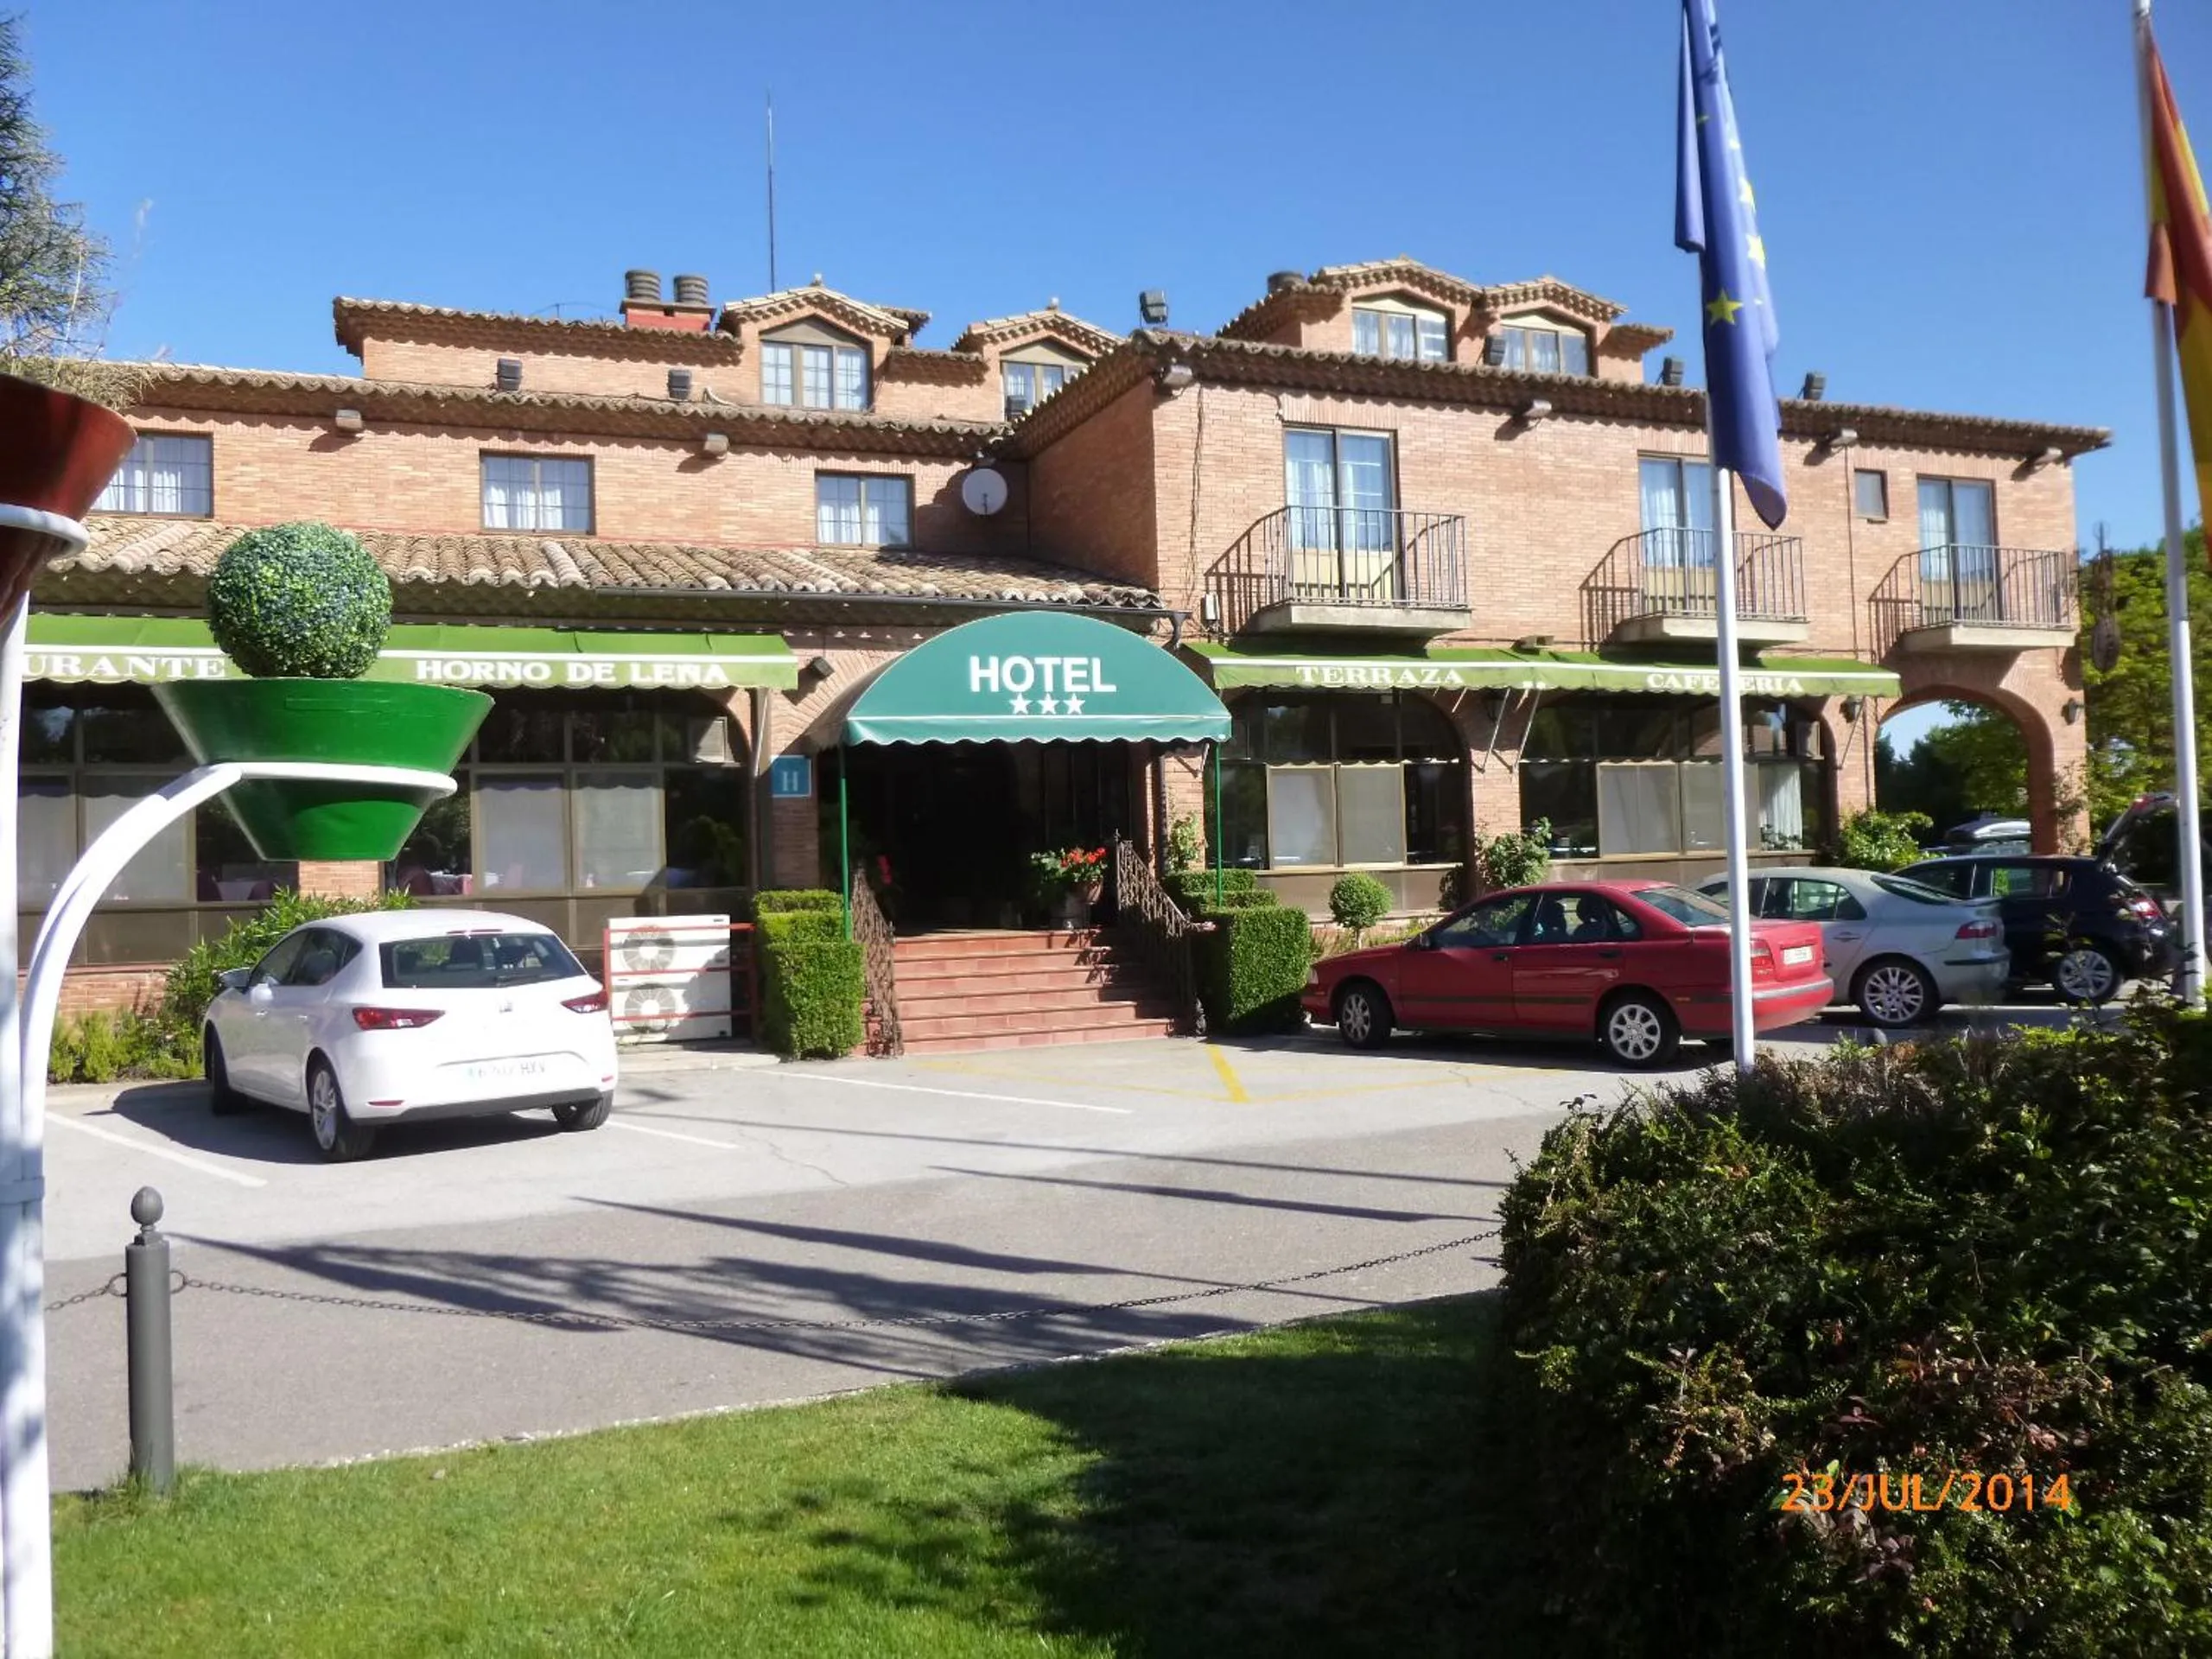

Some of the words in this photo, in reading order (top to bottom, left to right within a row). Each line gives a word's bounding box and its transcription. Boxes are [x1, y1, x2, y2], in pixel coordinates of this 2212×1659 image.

[416, 659, 551, 683] HORNO
[567, 661, 616, 683] DE
[969, 655, 1117, 692] HOTEL
[1296, 665, 1465, 685] TERRAZA
[1646, 672, 1804, 693] CAFEERIA
